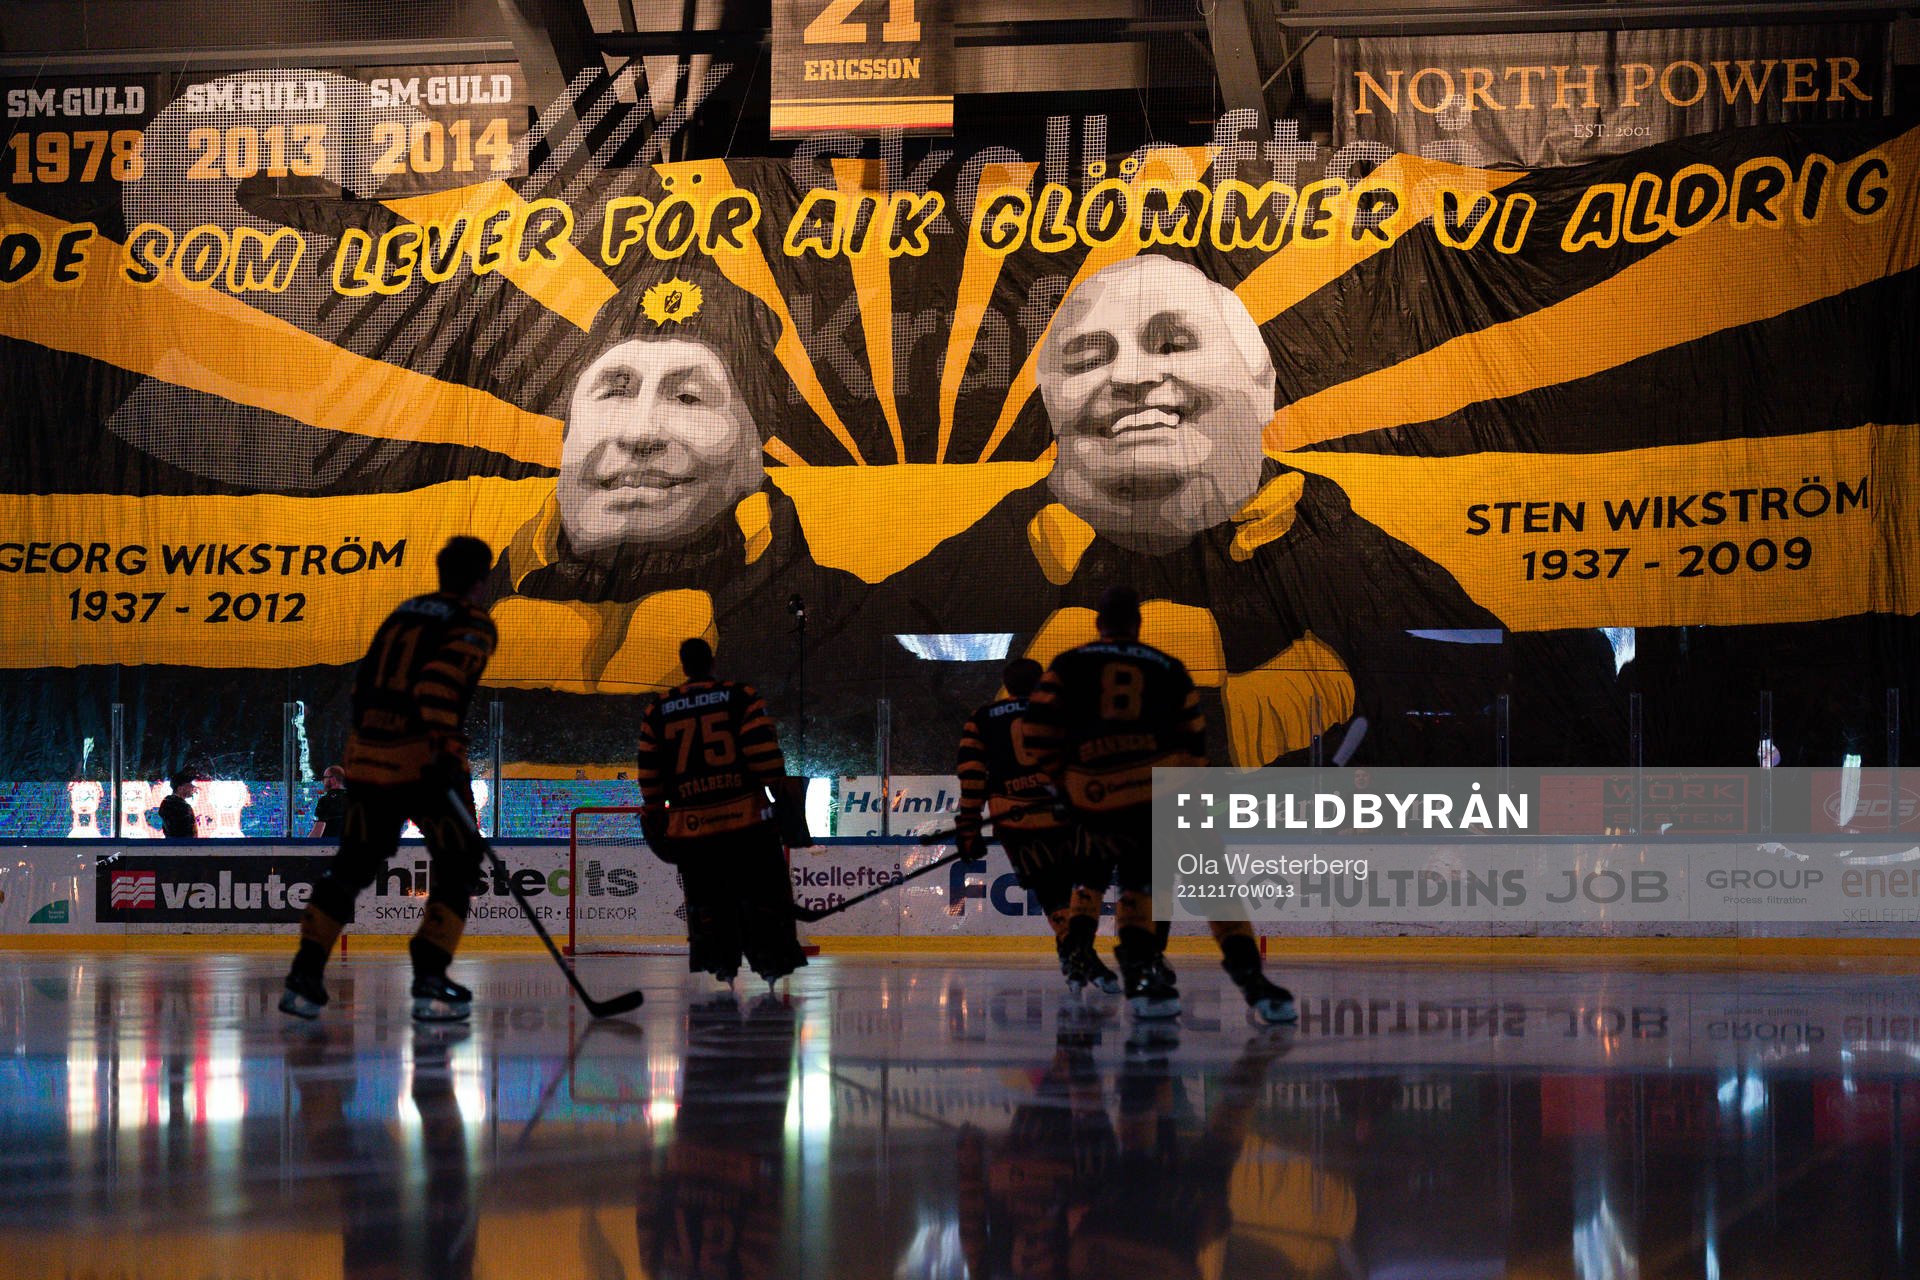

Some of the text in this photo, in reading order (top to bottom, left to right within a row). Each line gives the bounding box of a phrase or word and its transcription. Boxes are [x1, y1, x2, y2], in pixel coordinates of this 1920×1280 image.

[804, 58, 921, 81] ERICSSON
[1354, 56, 1873, 115] NORTH POWER
[7, 86, 145, 117] SM-GULD
[186, 79, 326, 113] SM-GULD
[370, 73, 513, 107] SM-GULD
[370, 118, 514, 175] 2014
[1574, 124, 1652, 138] EST. 2001
[8, 130, 145, 185] 1978
[187, 123, 328, 181] 2013
[0, 150, 1892, 297] DE SOM LEVER FÖR AIK GLÖMMER VI ALDRIG
[788, 274, 1075, 405] Kraf
[1465, 478, 1870, 537] STEN WIKSTRÖM
[0, 536, 408, 576] GEORG WIKSTRÖM
[1522, 548, 1631, 581] 1937
[1677, 536, 1813, 578] 2009
[68, 588, 166, 623] 1937
[204, 591, 308, 623] 2012
[374, 622, 425, 690] 11
[664, 690, 731, 715] BOLIDEN
[1101, 661, 1146, 721] 8
[664, 711, 737, 775] 75
[844, 789, 962, 814] Holmlu
[1611, 784, 1737, 800] WORK
[160, 870, 314, 910] valute
[376, 860, 640, 897] histedts
[791, 863, 904, 887] Skellefteå
[1301, 870, 1527, 907] HULTDINS
[1546, 871, 1669, 903] JOB
[1706, 870, 1824, 889] GROUP
[376, 907, 426, 919] SKYLTA
[468, 907, 553, 919] NDEROLER
[797, 893, 846, 913] raft
[1723, 895, 1807, 905] Process filtration
